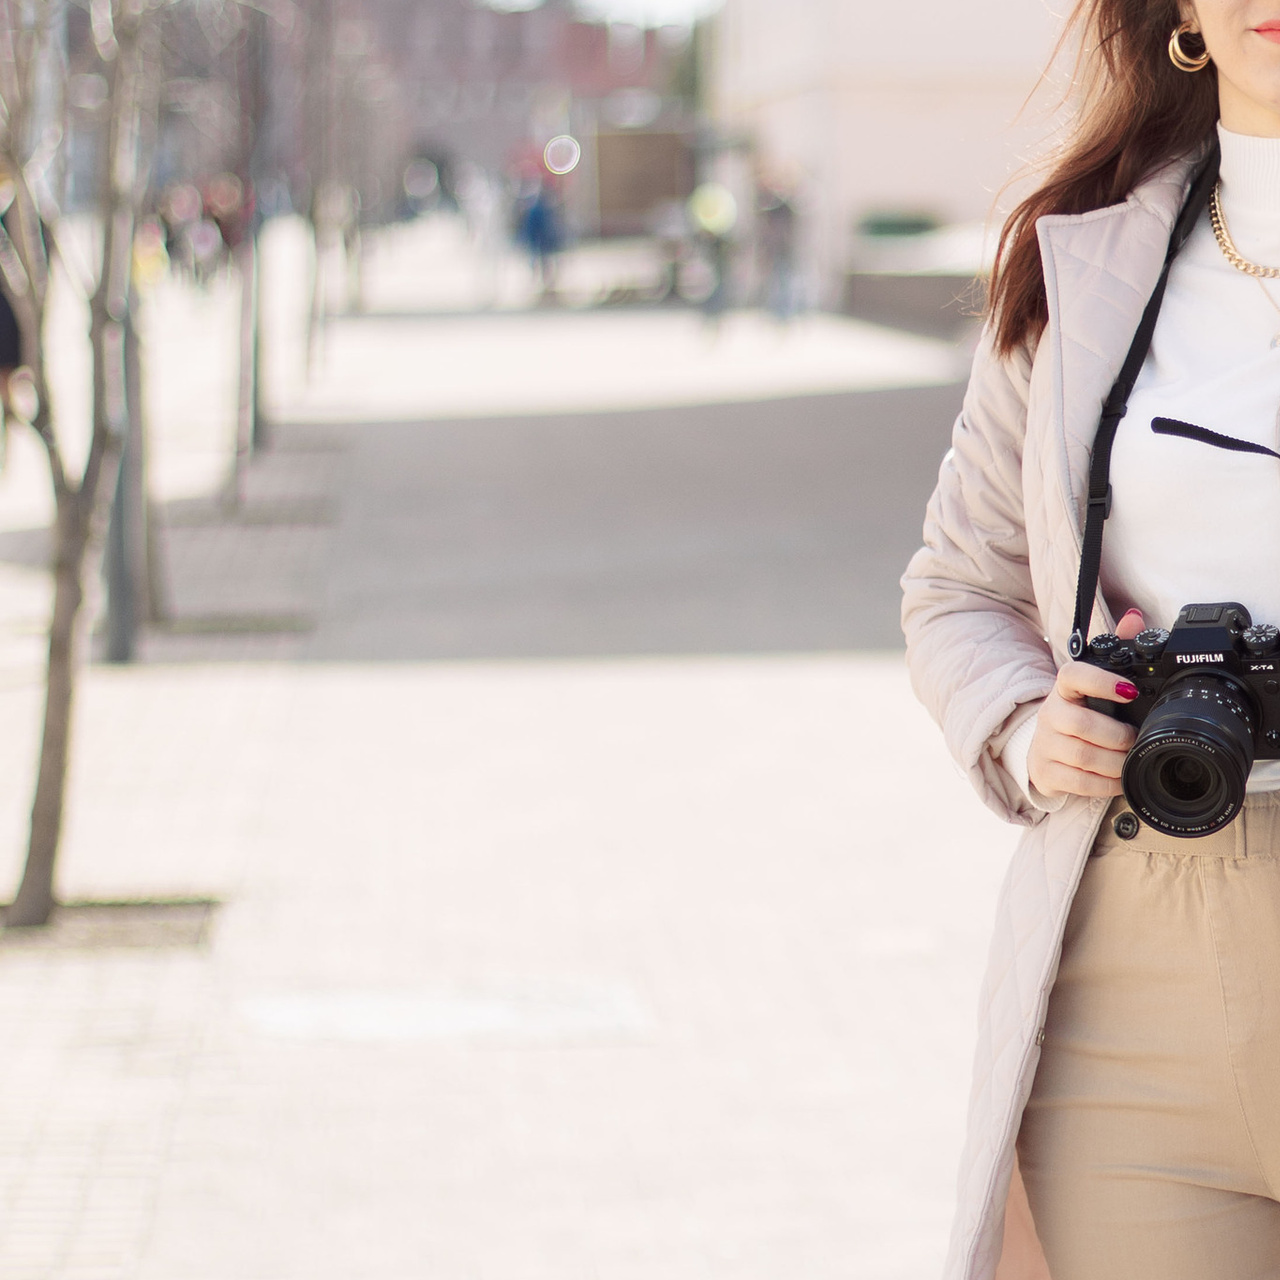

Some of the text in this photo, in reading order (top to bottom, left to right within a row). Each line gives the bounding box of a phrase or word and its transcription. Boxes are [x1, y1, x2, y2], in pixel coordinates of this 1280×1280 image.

[1176, 653, 1224, 664] FUJIFILM
[1138, 738, 1215, 757] FUJINON ASPHERICAL LENS
